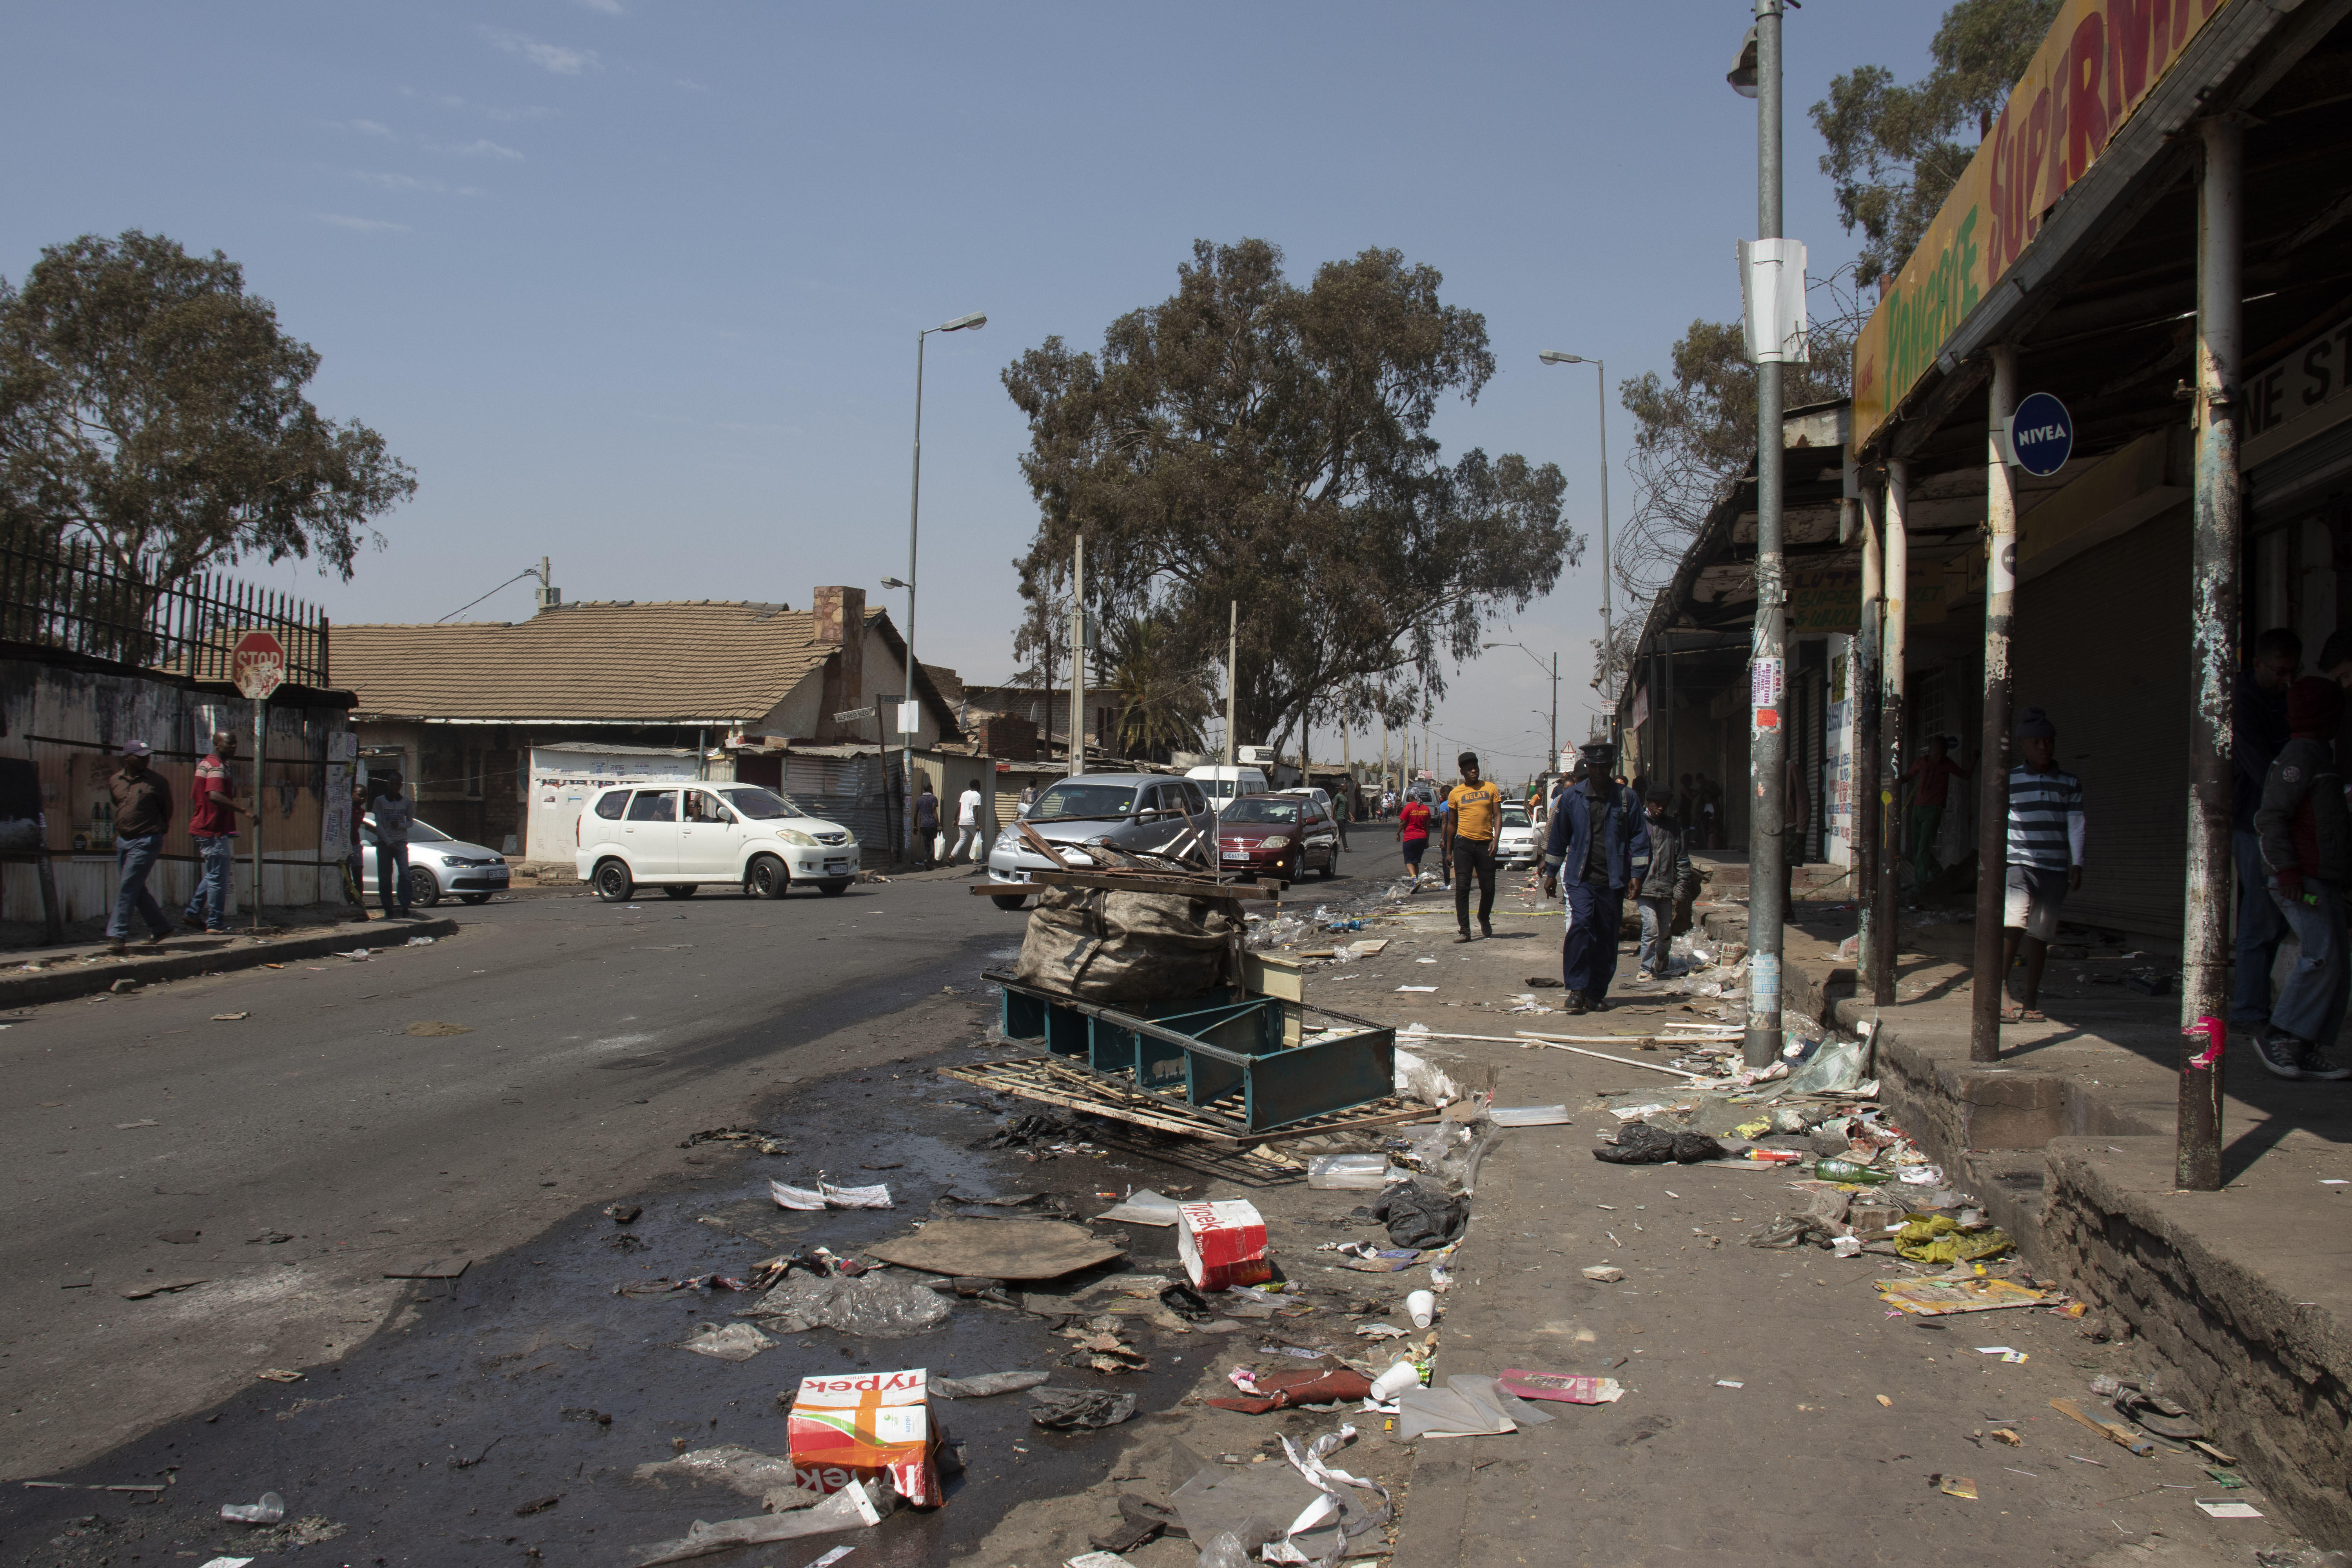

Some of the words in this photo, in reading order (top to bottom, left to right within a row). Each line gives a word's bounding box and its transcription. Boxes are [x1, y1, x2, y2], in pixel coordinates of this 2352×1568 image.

[2018, 423, 2067, 446] NIVEA
[238, 651, 280, 669] STOP
[837, 713, 857, 721] ALFRED
[1465, 791, 1486, 800] RELAY
[1182, 1202, 1225, 1231] Typek
[1196, 1234, 1205, 1256] Typek
[804, 1372, 927, 1394] Typek
